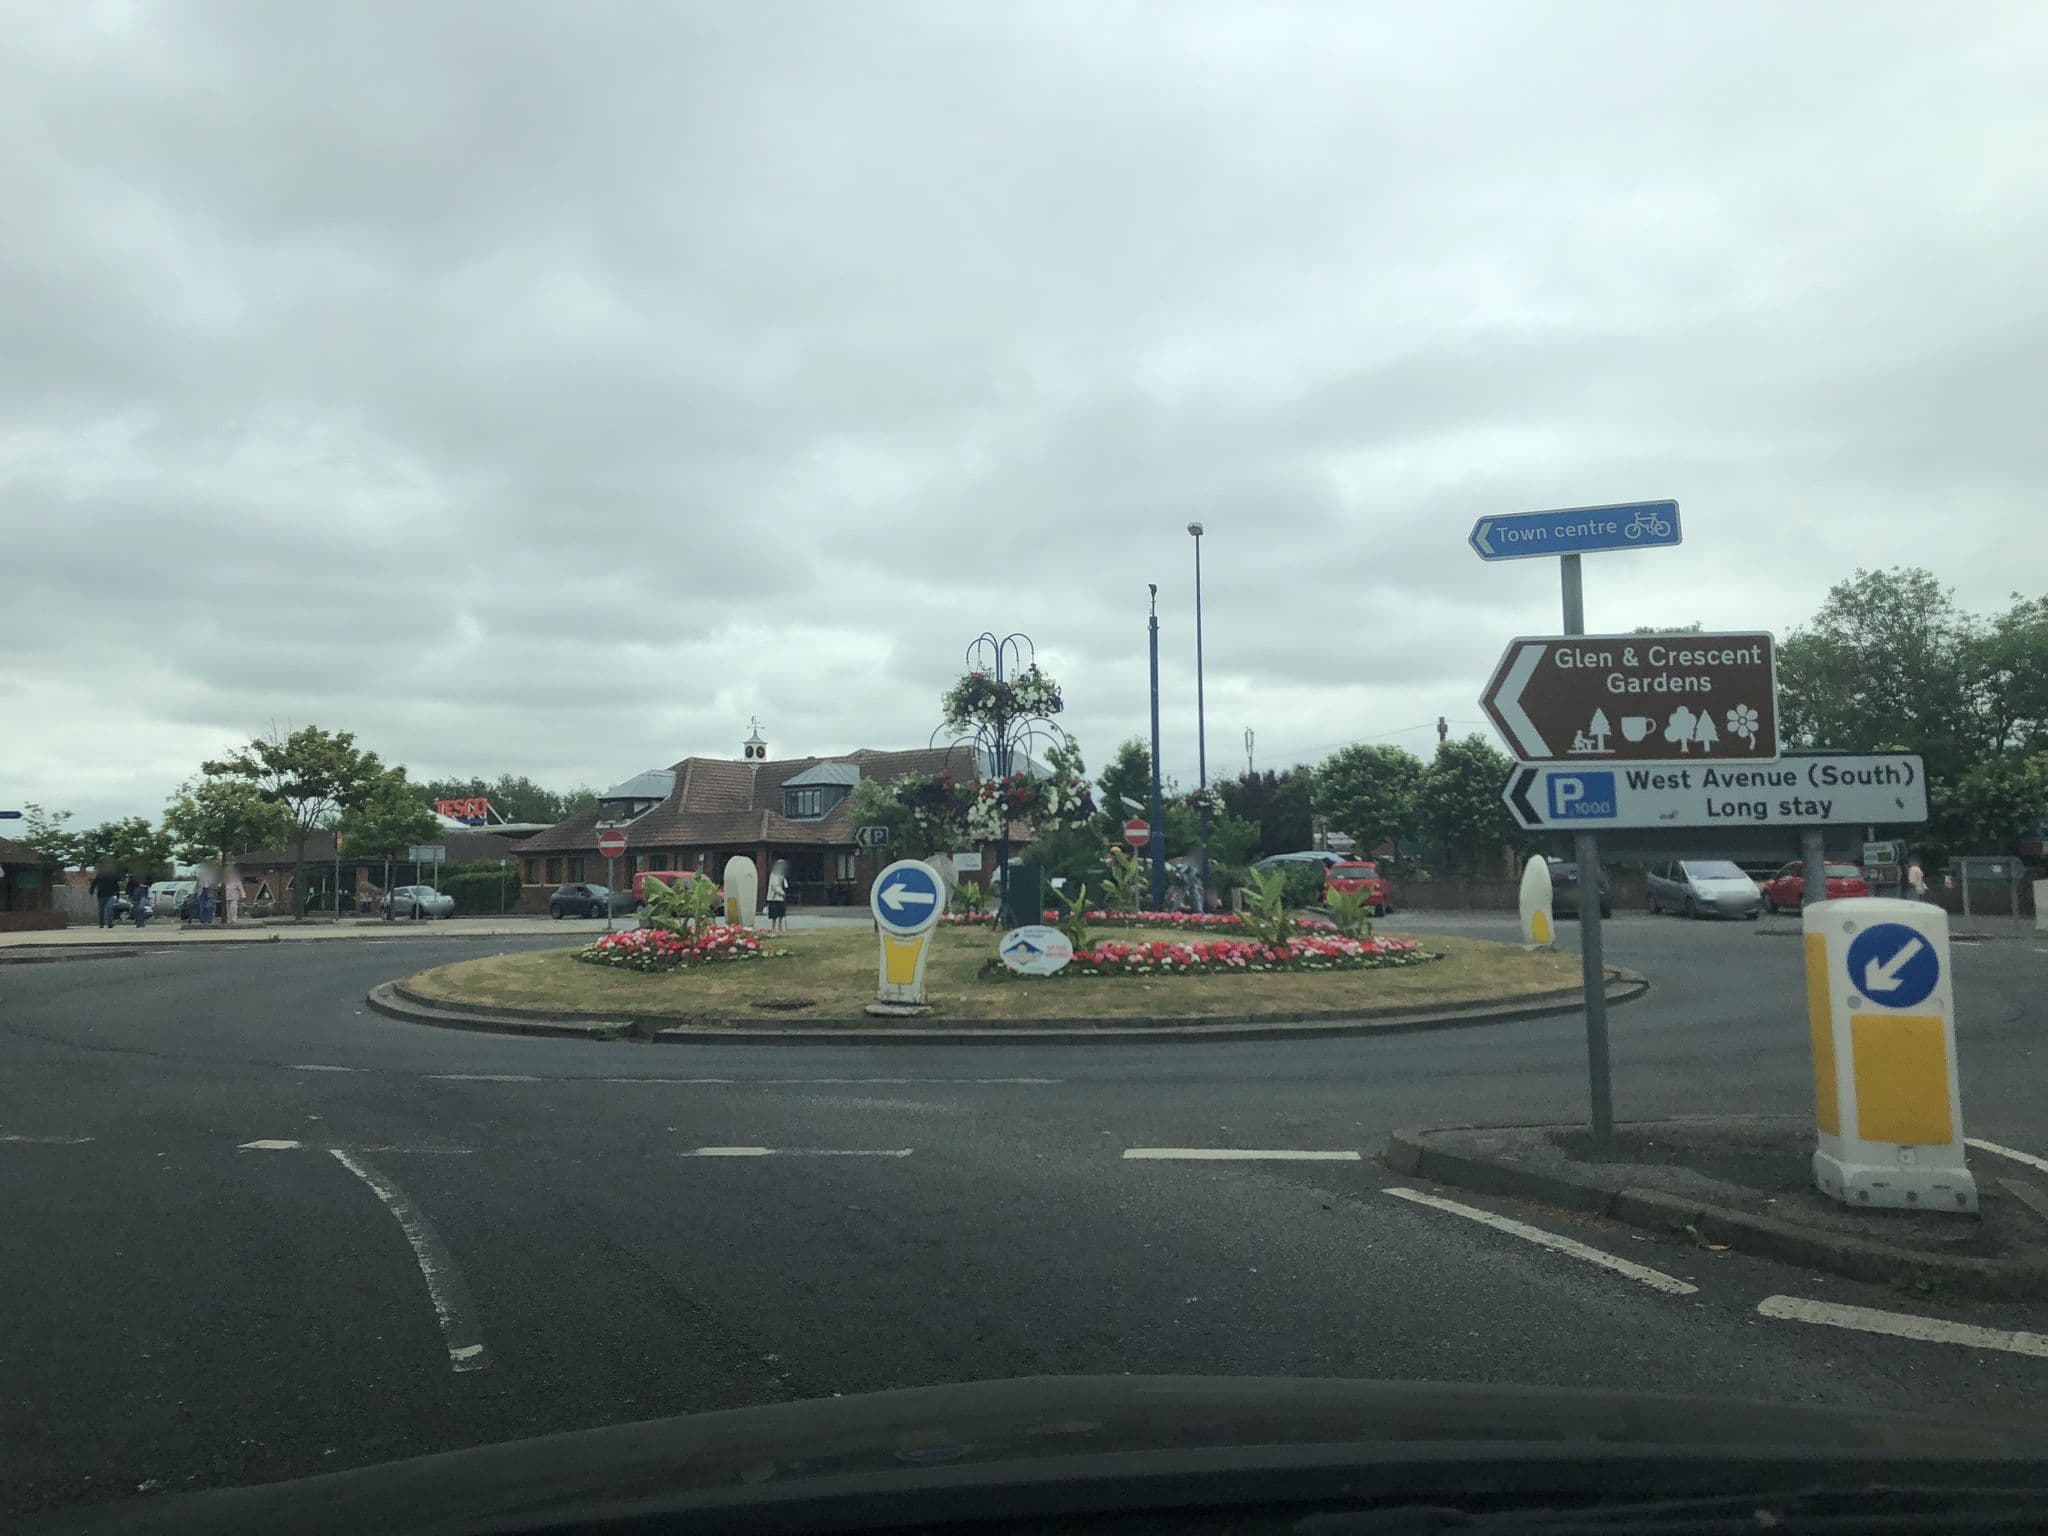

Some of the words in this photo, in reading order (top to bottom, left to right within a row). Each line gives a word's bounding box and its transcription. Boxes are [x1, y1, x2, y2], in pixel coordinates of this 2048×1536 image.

[1496, 526, 1547, 543] Town
[1554, 519, 1617, 538] centre
[1554, 648, 1613, 669] Glen
[1622, 647, 1640, 667] &
[1649, 644, 1762, 667] Crescent
[1606, 672, 1712, 694] Gardens
[1625, 769, 1692, 790] West
[1702, 767, 1798, 788] Avenue
[1807, 761, 1915, 789] (South)
[433, 797, 489, 818] TESCO
[1554, 777, 1585, 816] P
[1574, 801, 1611, 815] 1000
[1706, 797, 1768, 821] Long
[1779, 796, 1833, 819] stay
